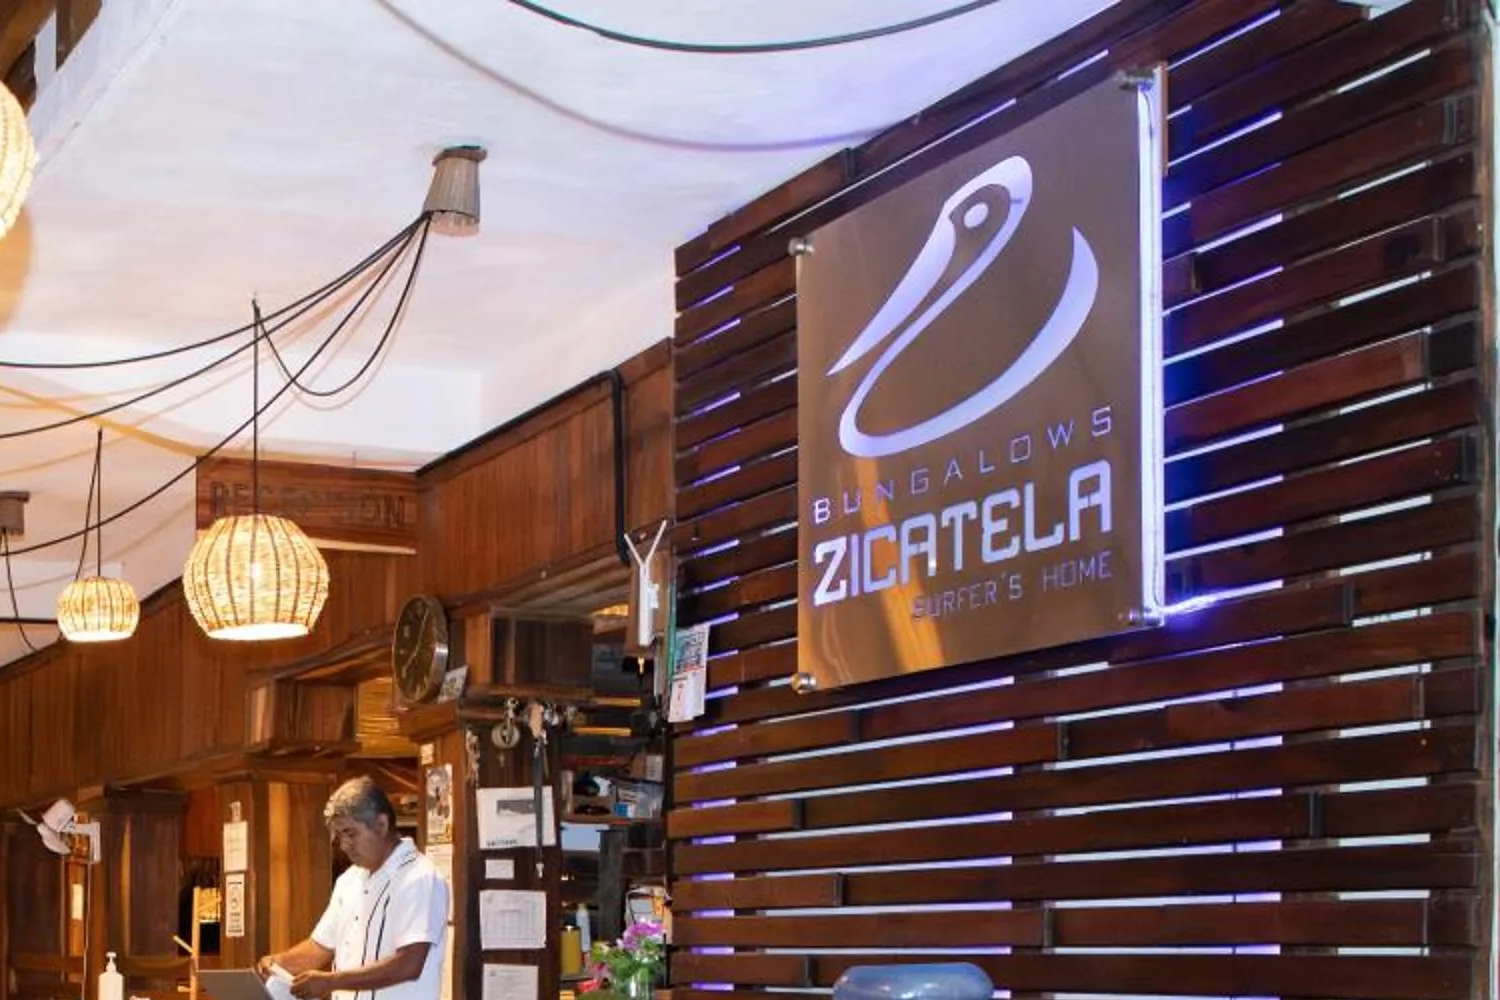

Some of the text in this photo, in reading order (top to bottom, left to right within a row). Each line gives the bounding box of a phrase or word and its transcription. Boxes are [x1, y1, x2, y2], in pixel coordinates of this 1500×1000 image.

[812, 405, 1112, 525] BUNGALOWS
[812, 459, 1112, 607] ZICATELA
[1042, 551, 1113, 592] HOME
